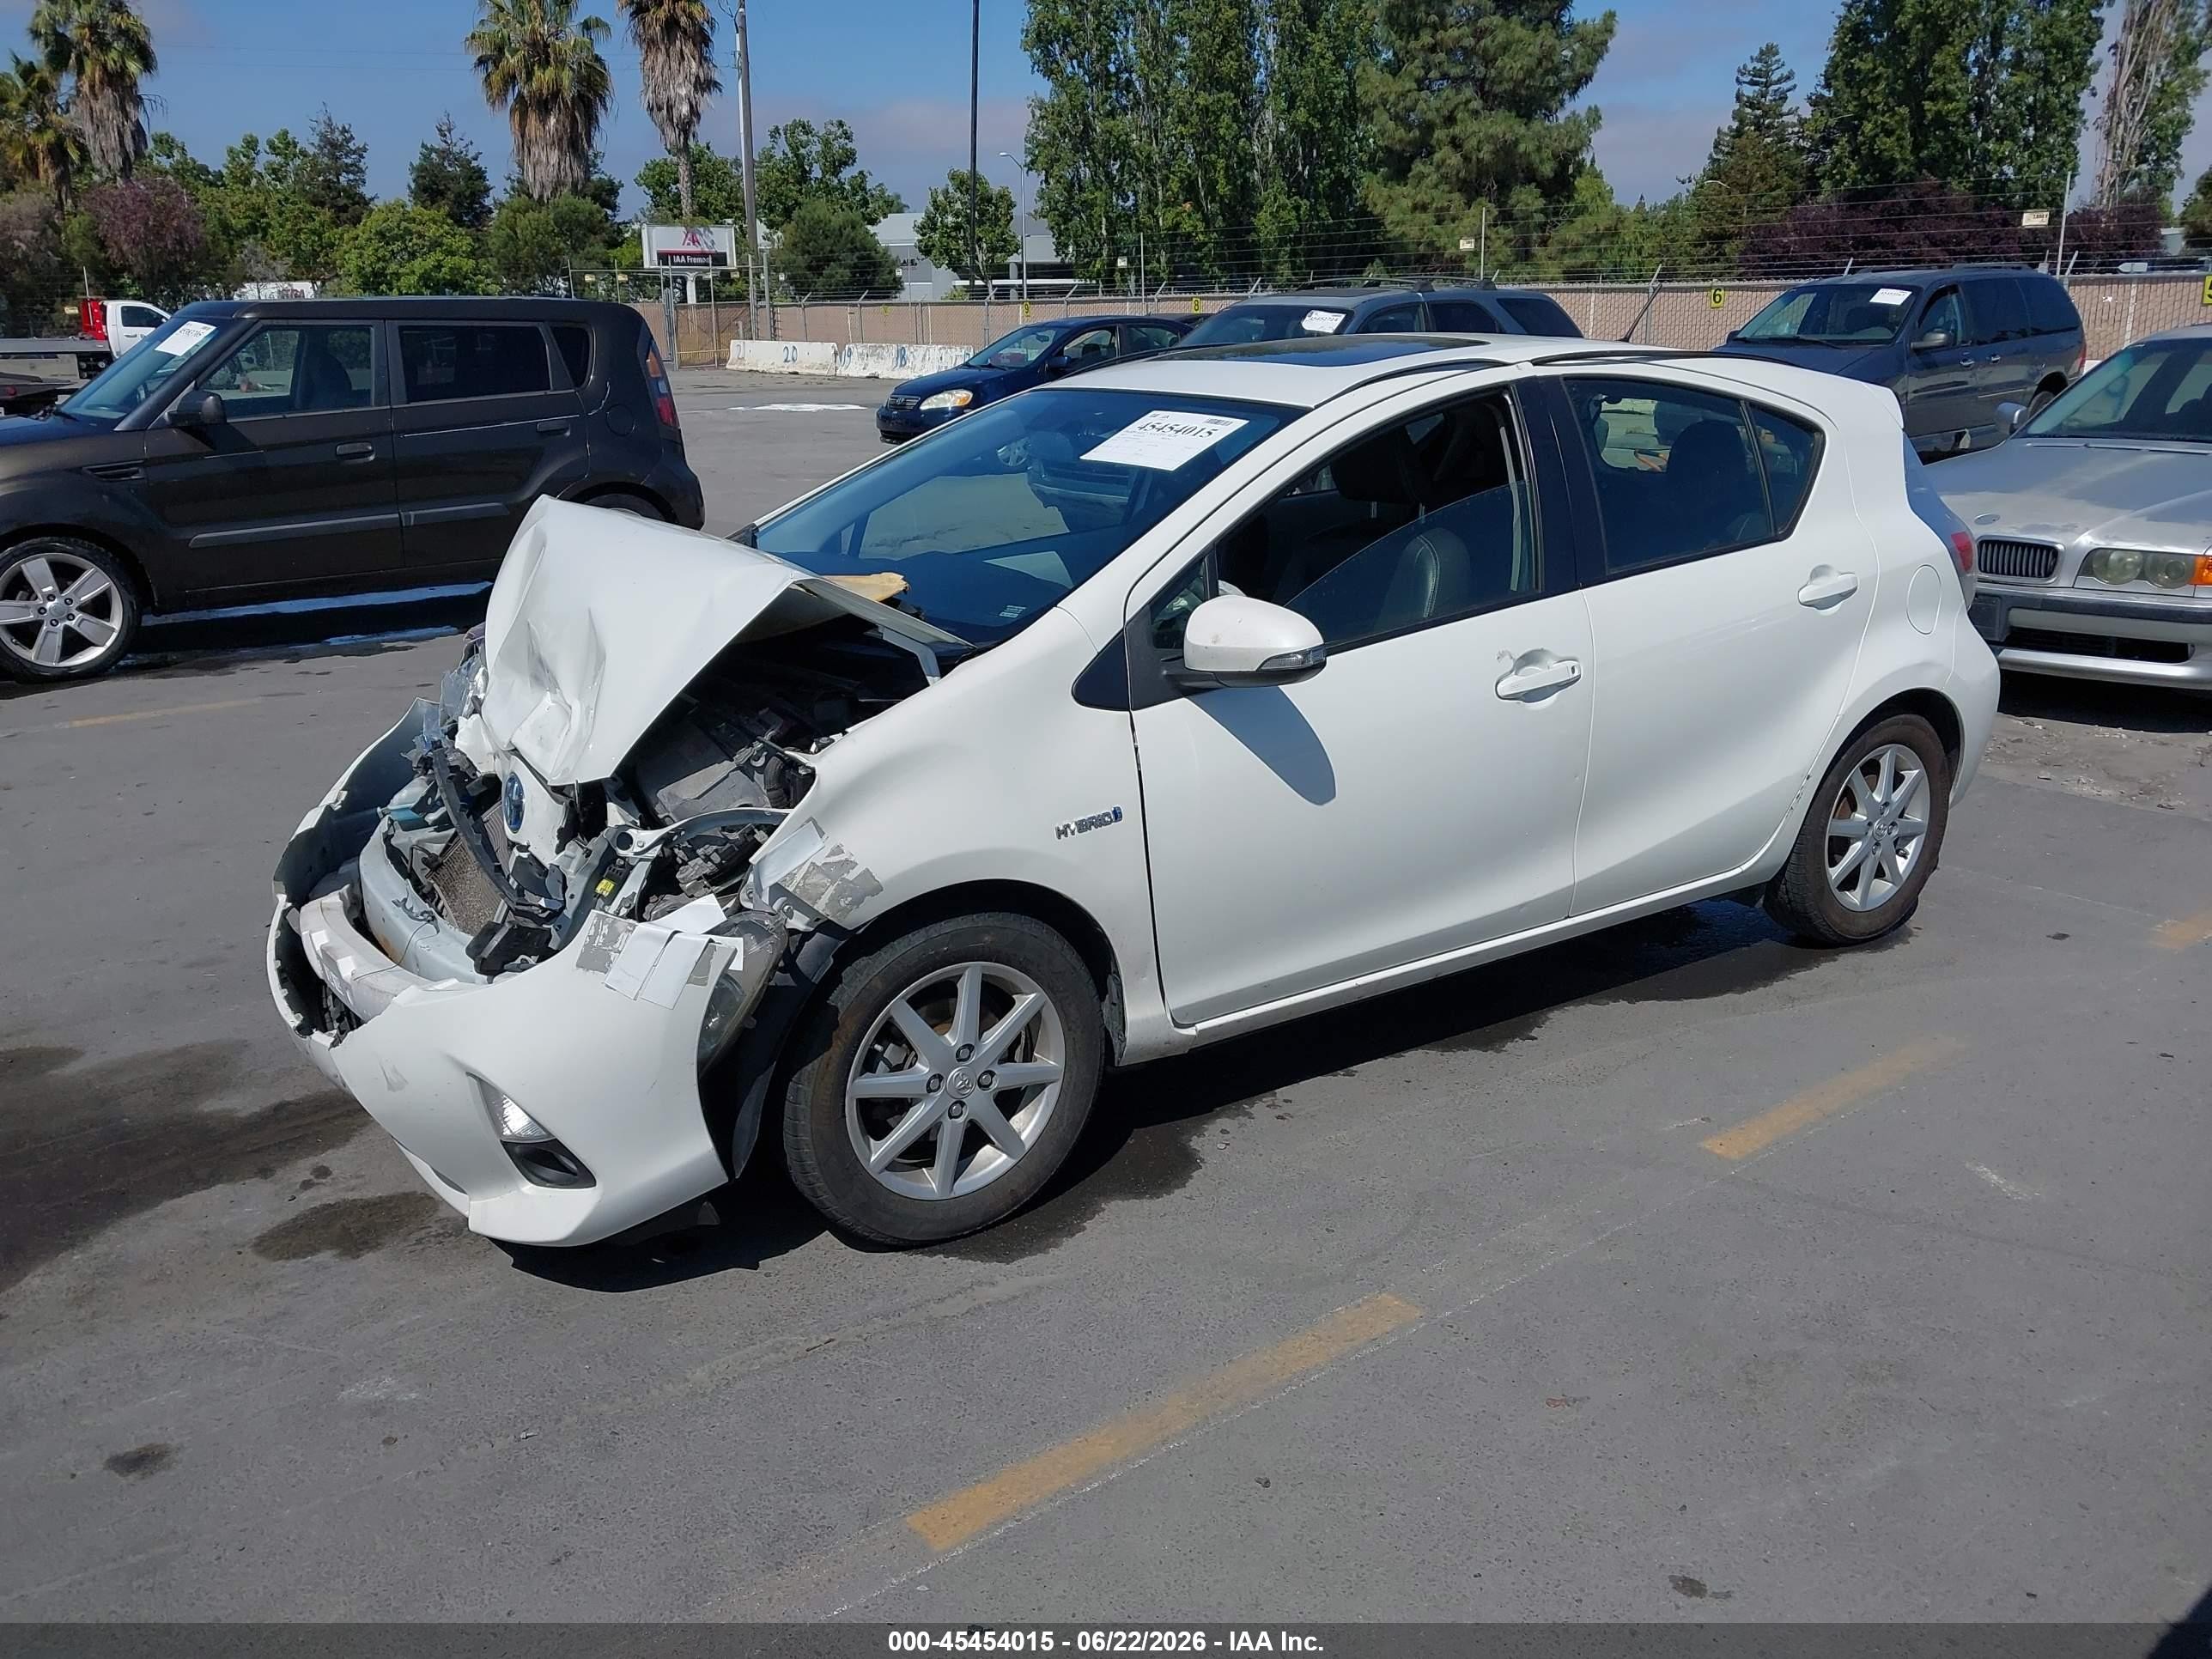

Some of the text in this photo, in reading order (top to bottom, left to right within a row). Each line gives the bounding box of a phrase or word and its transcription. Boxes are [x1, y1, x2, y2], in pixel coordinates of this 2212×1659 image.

[1713, 289, 1722, 304] 6
[1194, 300, 1199, 311] 8
[782, 345, 798, 362] 20
[1137, 422, 1219, 439] 45454015
